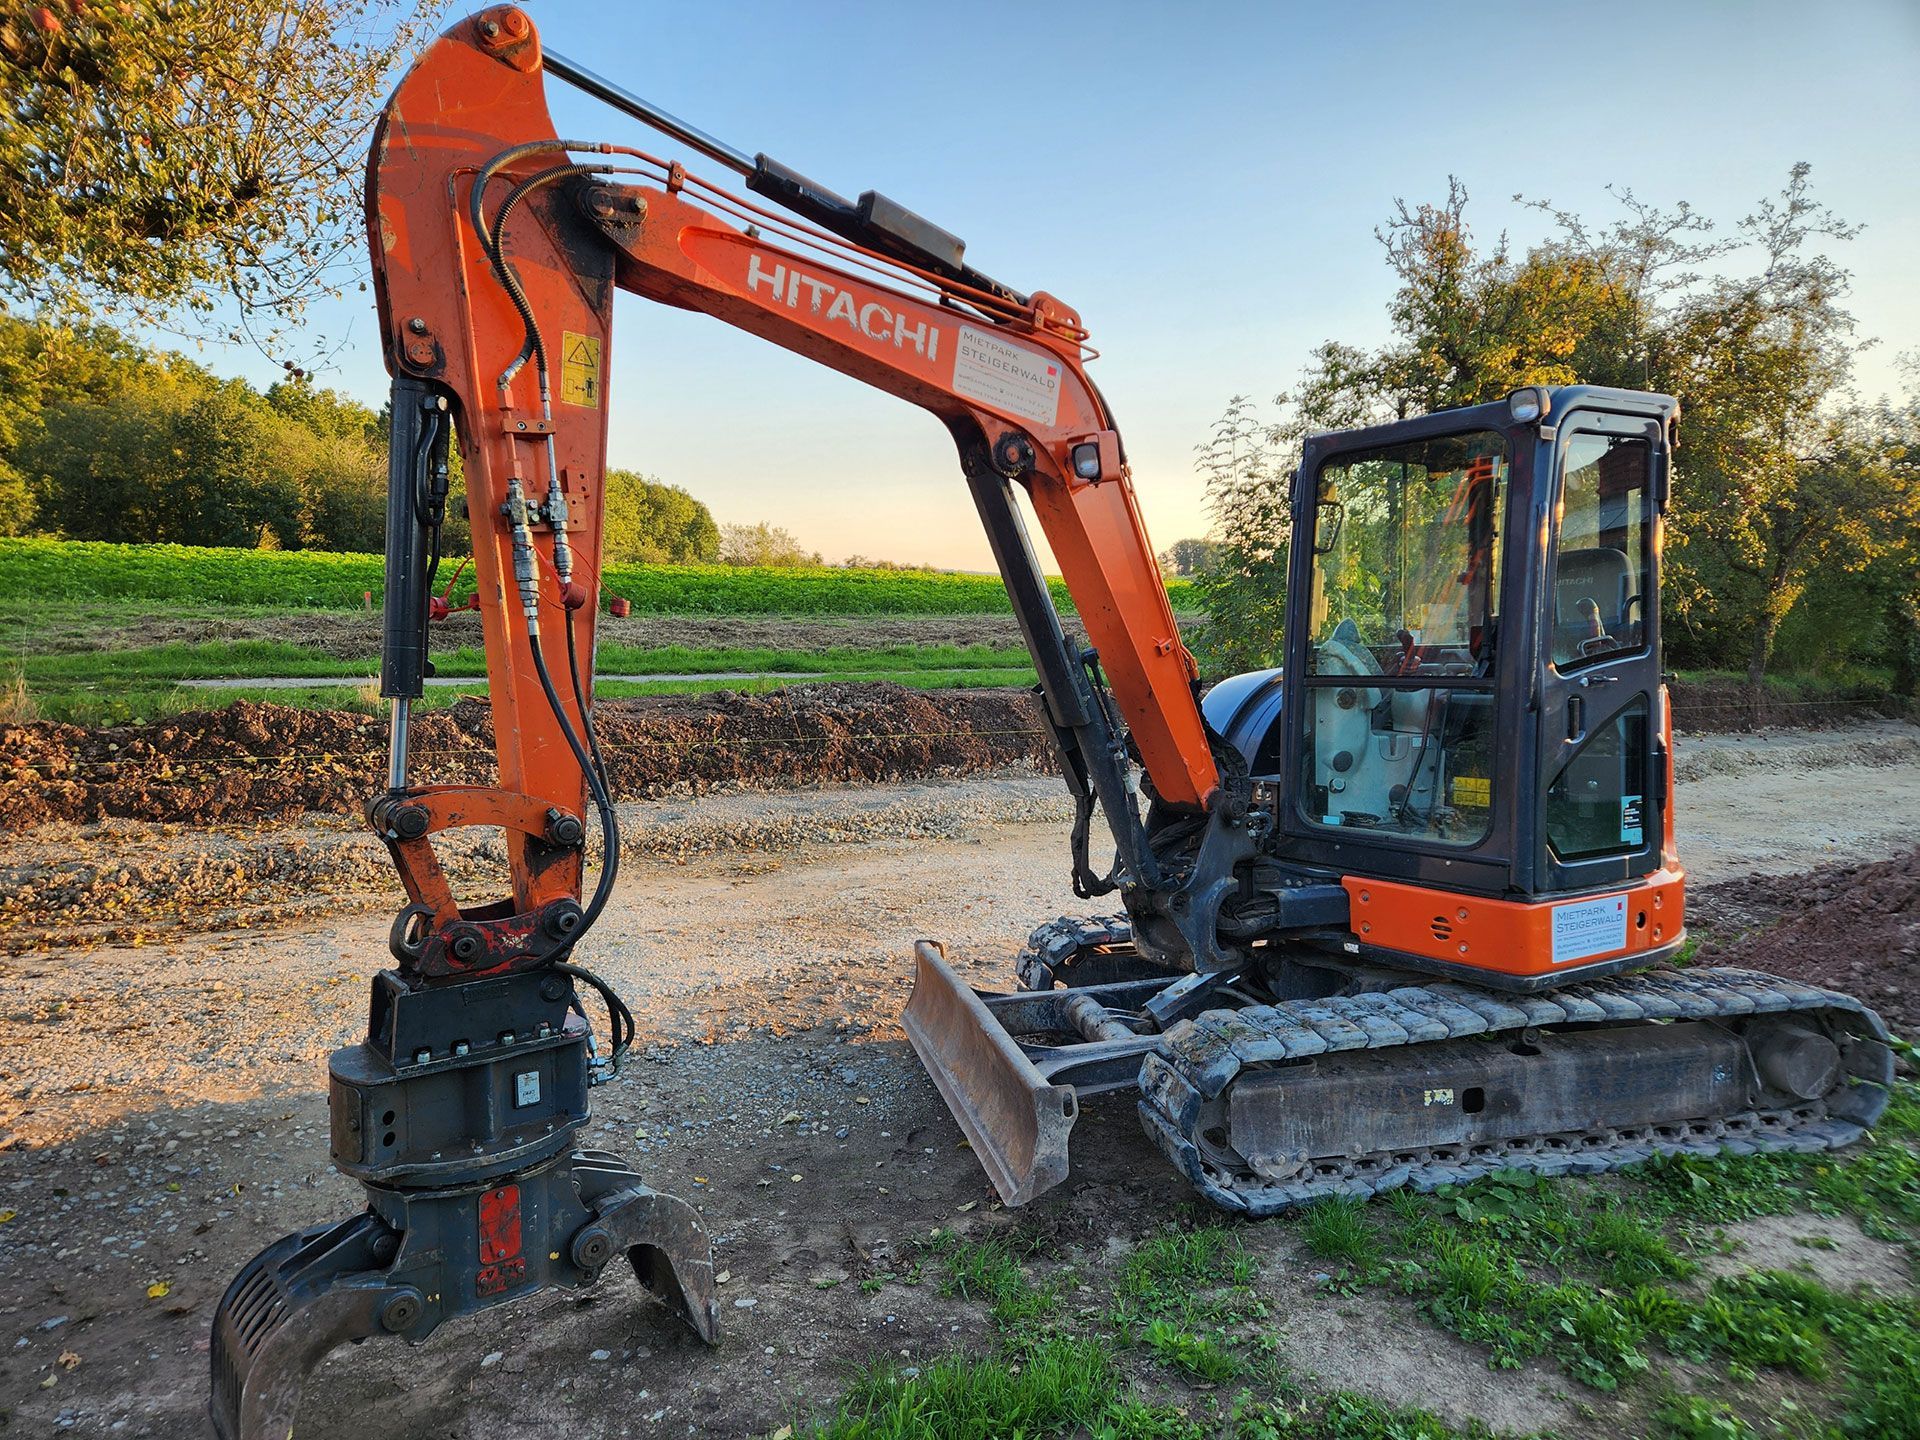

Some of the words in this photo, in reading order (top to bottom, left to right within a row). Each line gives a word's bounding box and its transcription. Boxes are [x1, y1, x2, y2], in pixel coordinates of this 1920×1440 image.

[748, 254, 939, 362] HITACHI
[963, 331, 1019, 361] MIETPARK
[961, 345, 1056, 389] STEIGERWALD
[1557, 906, 1606, 922] MIETPARK
[1557, 913, 1623, 934] STEIGERWALD
